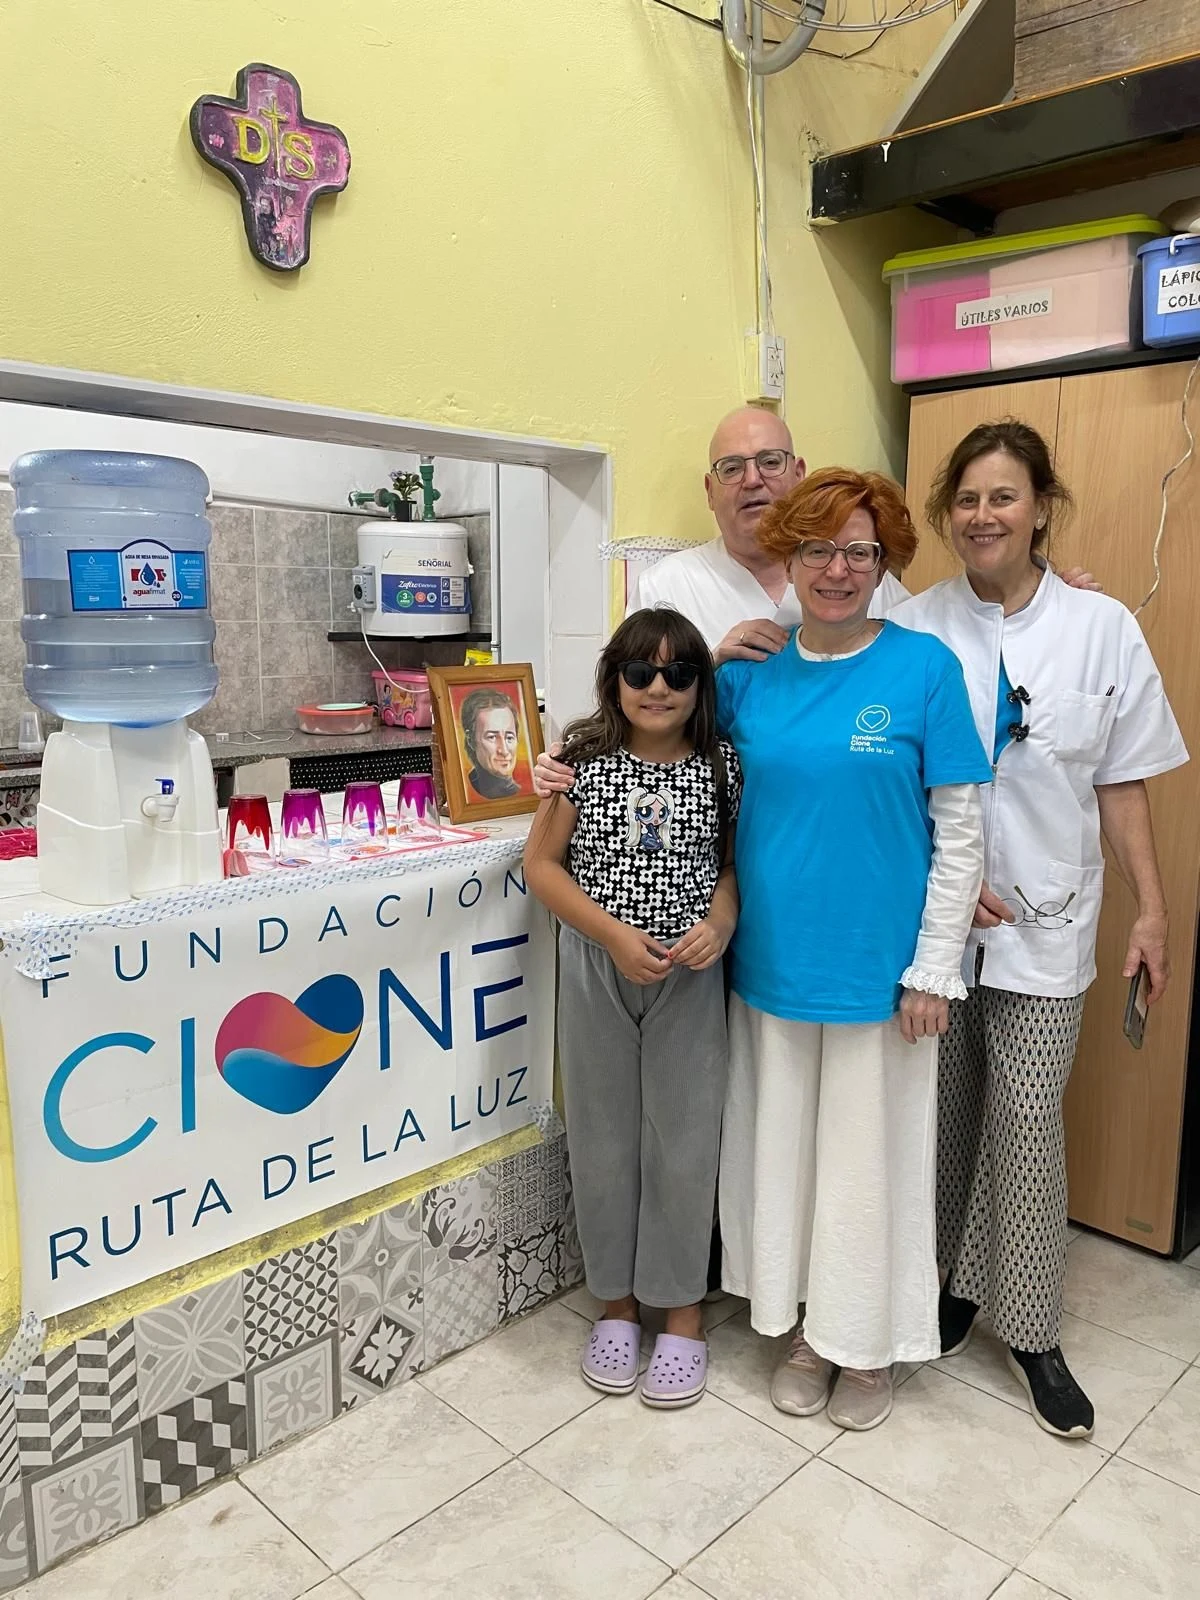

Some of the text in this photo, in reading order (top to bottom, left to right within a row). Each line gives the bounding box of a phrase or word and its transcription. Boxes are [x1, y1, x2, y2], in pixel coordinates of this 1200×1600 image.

[961, 300, 1049, 327] ÚTILES VARIOS
[1168, 293, 1200, 308] COL
[418, 559, 451, 567] SEÑORIAL
[41, 866, 527, 998] FUNDACIÓN
[49, 1066, 529, 1281] RUTA DE LA LUZ
